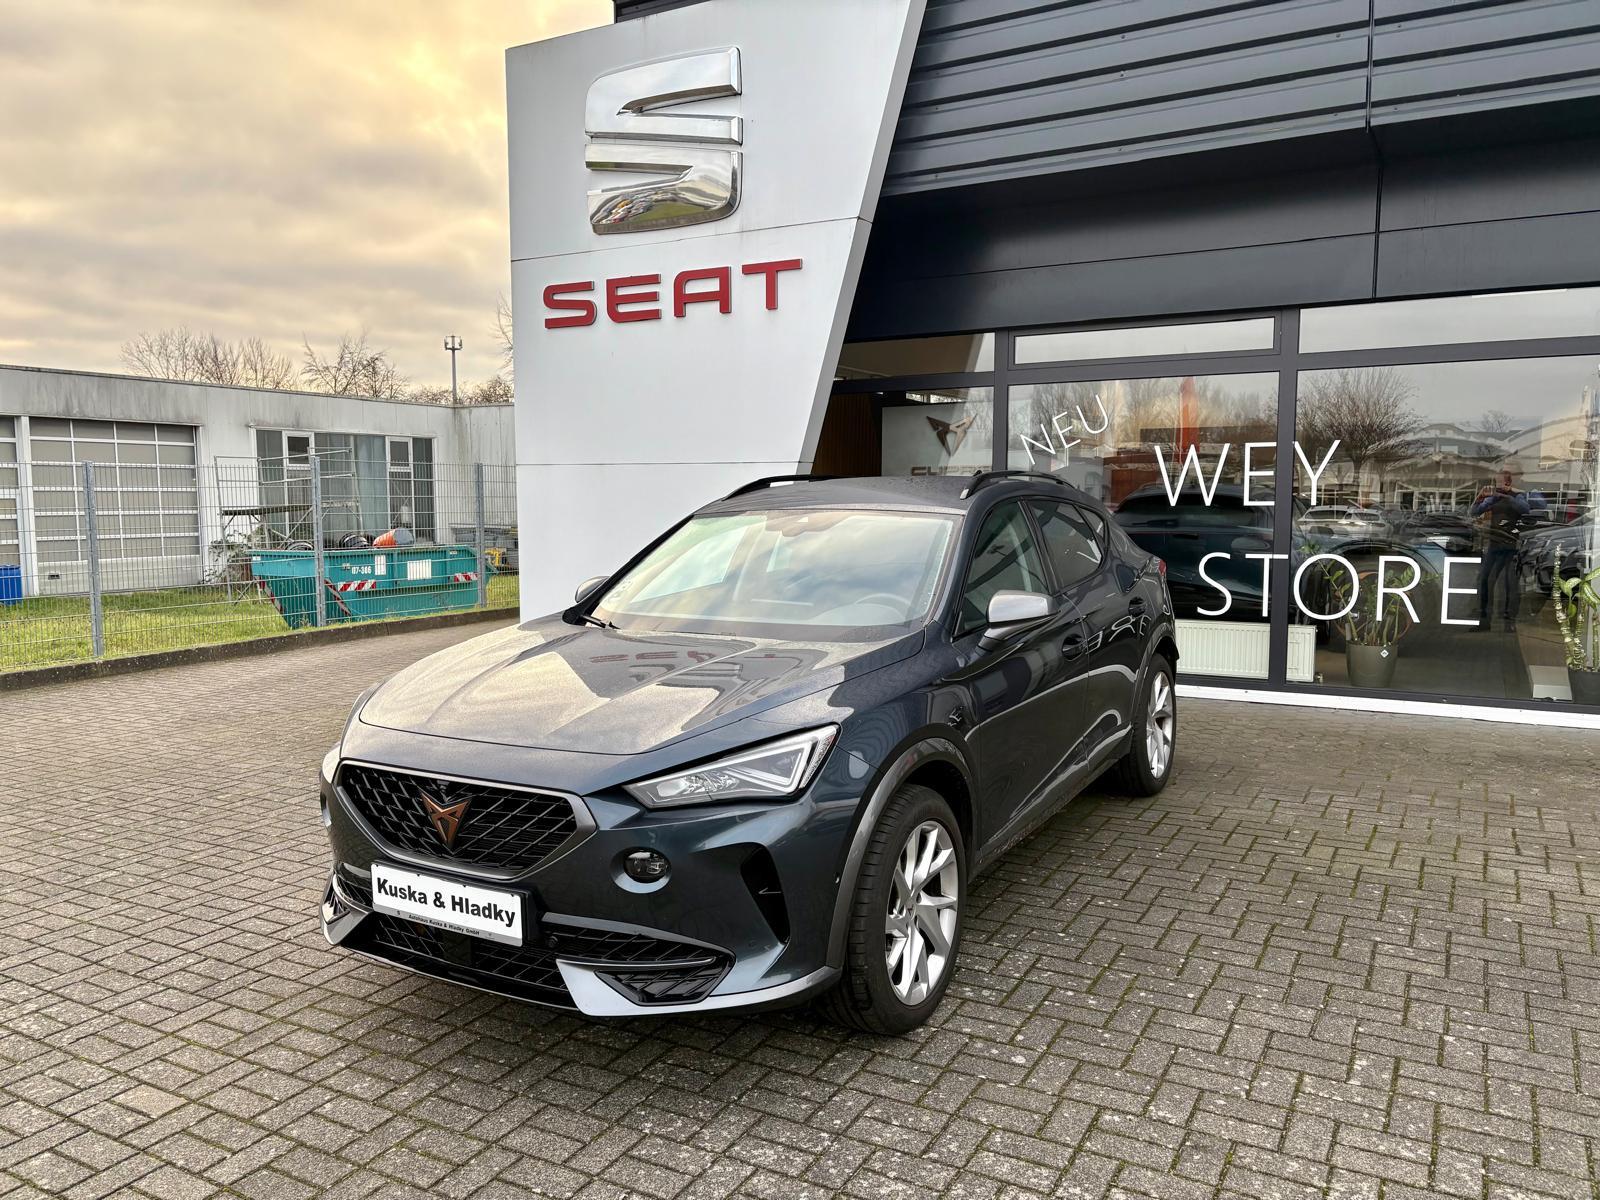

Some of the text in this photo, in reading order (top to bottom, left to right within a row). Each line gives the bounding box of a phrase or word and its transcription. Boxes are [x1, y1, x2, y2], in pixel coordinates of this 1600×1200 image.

[543, 258, 803, 329] SEAT
[1020, 394, 1108, 465] NEU
[1154, 439, 1341, 507] WEY
[1196, 551, 1482, 626] STORE
[377, 877, 516, 928] Kuska & Hladky
[429, 919, 443, 927] Kuska
